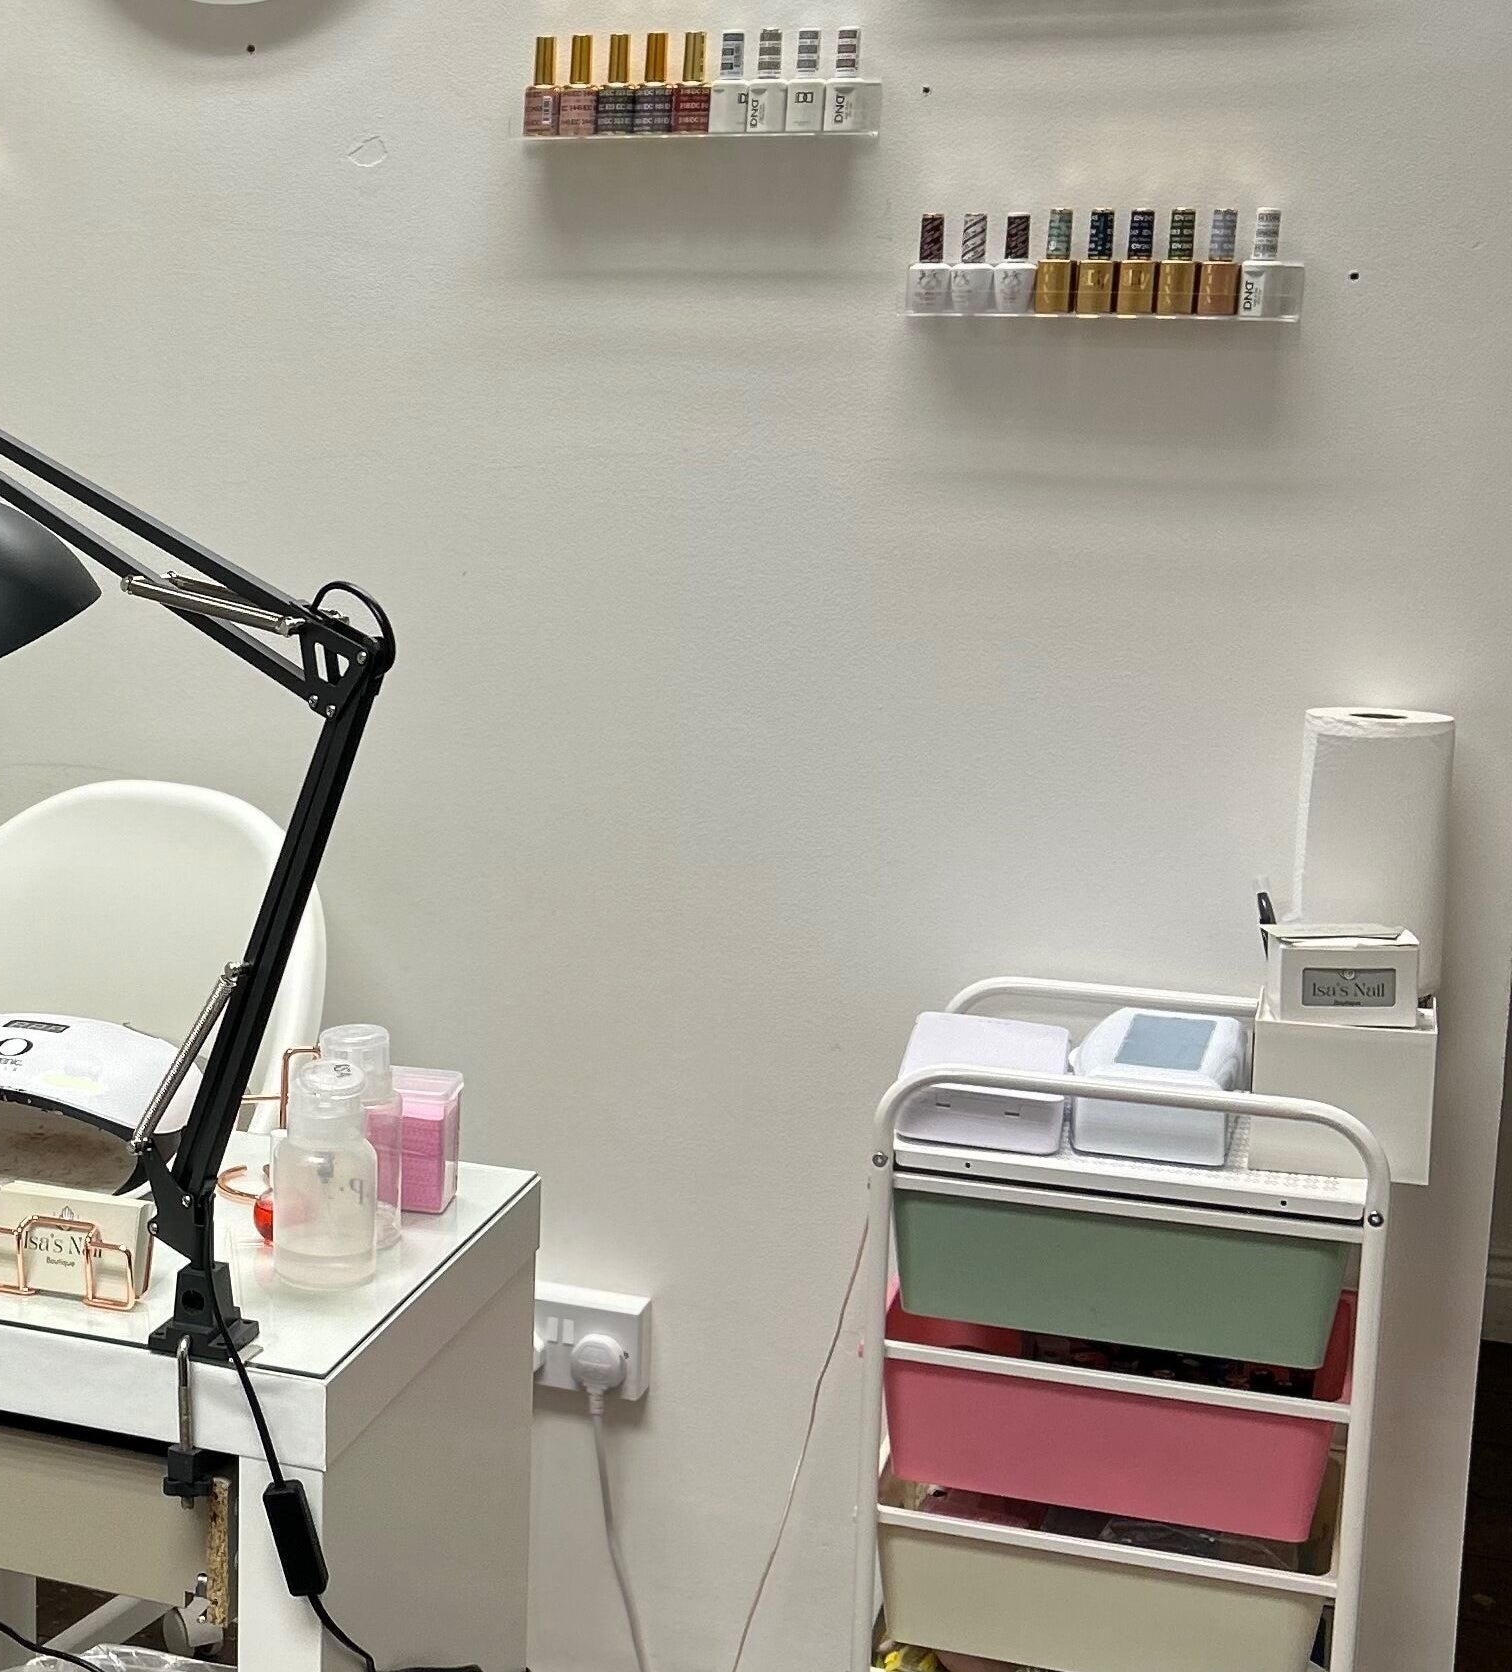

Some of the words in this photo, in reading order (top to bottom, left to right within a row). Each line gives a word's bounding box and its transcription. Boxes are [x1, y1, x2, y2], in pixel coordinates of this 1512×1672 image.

[834, 95, 845, 123] DND
[1243, 281, 1254, 311] DND
[1312, 982, 1349, 998] Isa's
[1354, 982, 1385, 998] Nail
[24, 1230, 64, 1254] Isa's
[46, 1256, 76, 1269] Boutique
